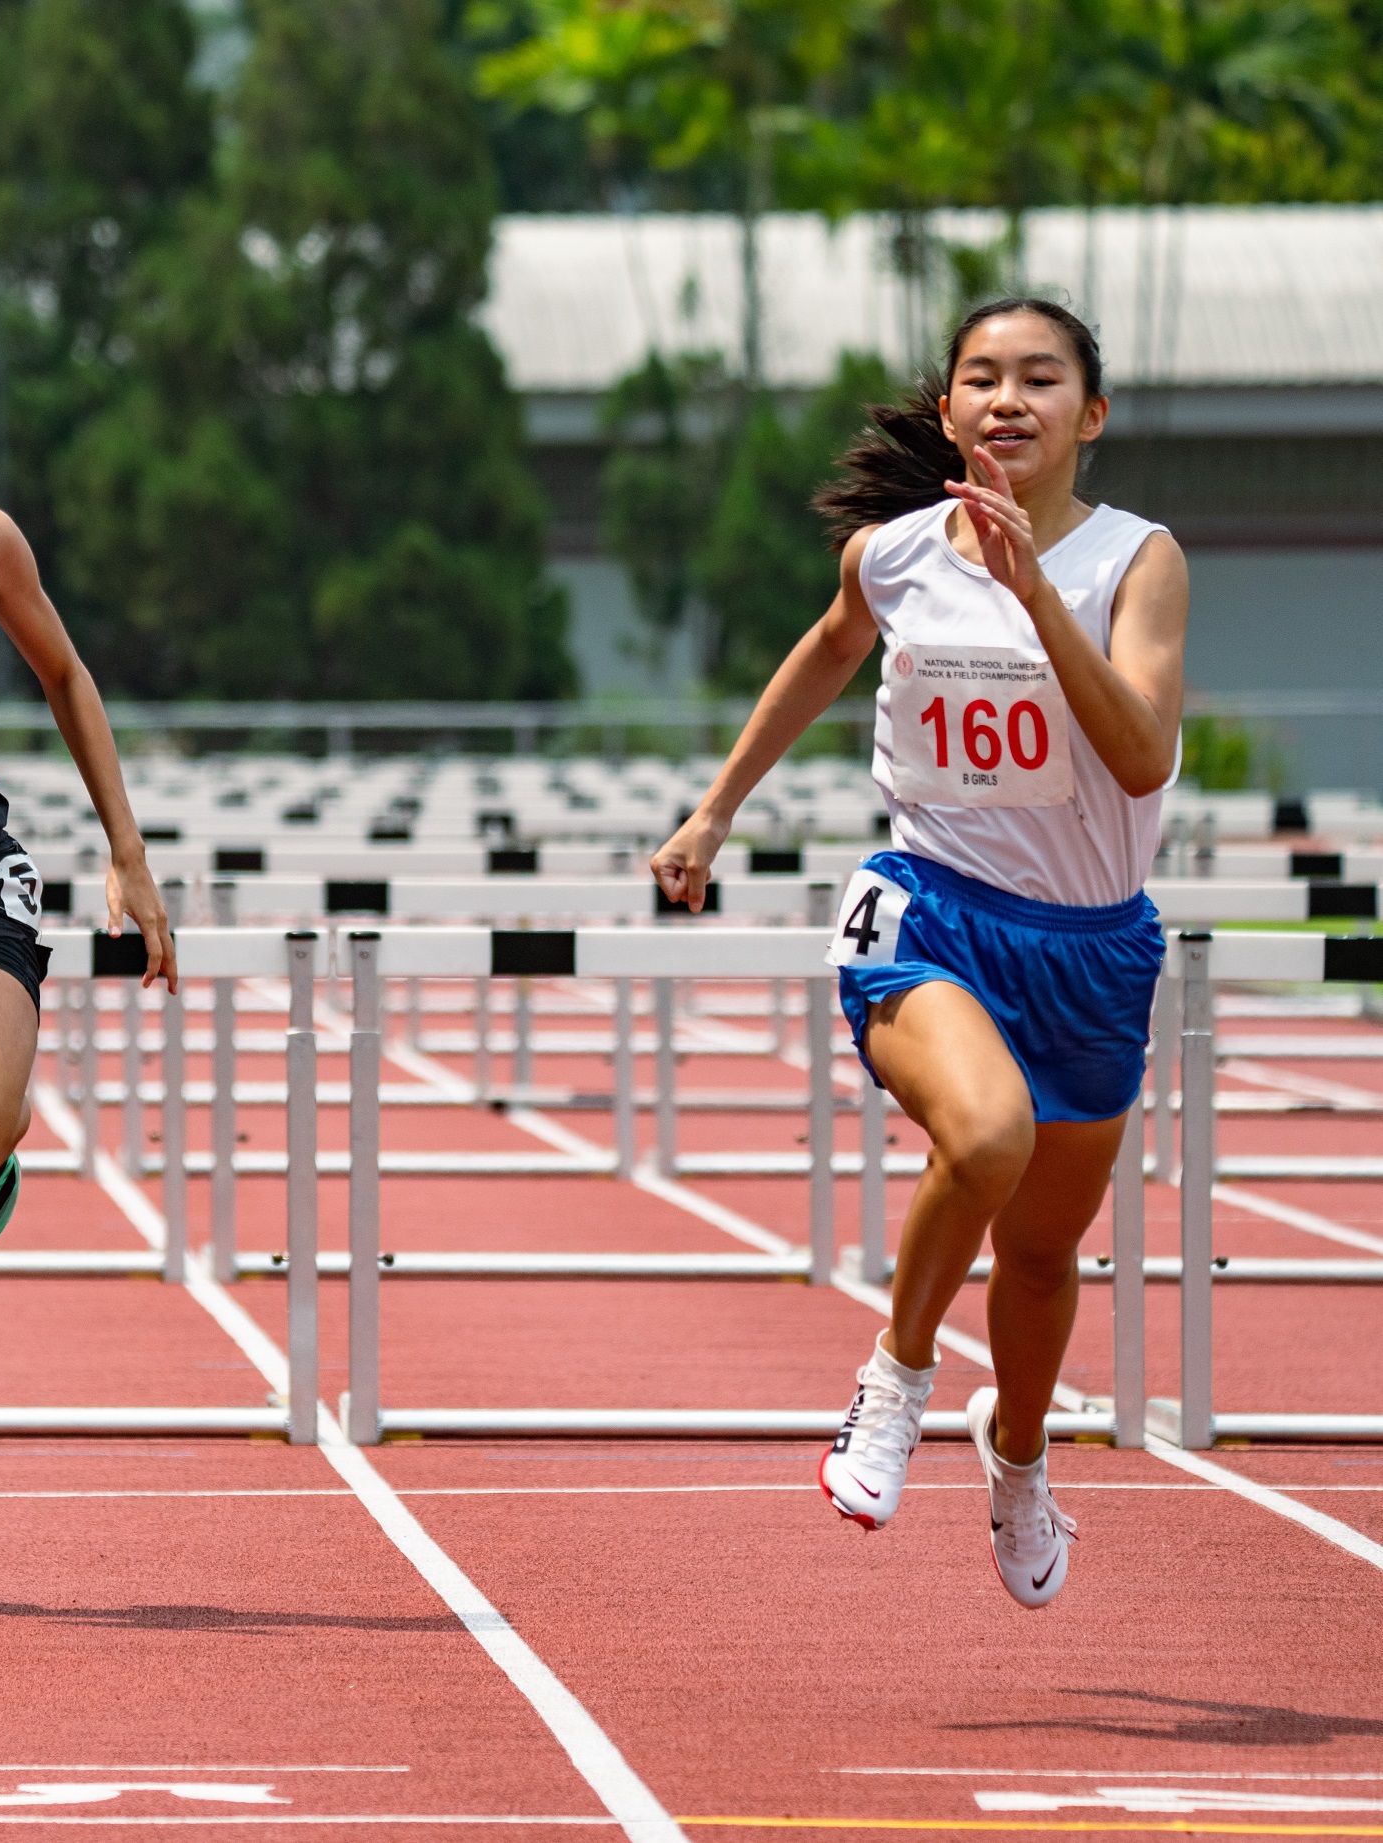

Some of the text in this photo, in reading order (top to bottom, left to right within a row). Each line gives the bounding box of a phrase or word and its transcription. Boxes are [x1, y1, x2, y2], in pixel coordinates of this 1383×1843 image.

[917, 669, 1047, 682] TRACK & FIELD CHAMPIONSHIPS
[924, 659, 1036, 671] NATIONAL SCHOOL GAMES
[920, 696, 1049, 771] 160
[963, 773, 998, 786] B GIRLS
[8, 862, 38, 916] 5
[843, 885, 884, 957] 4
